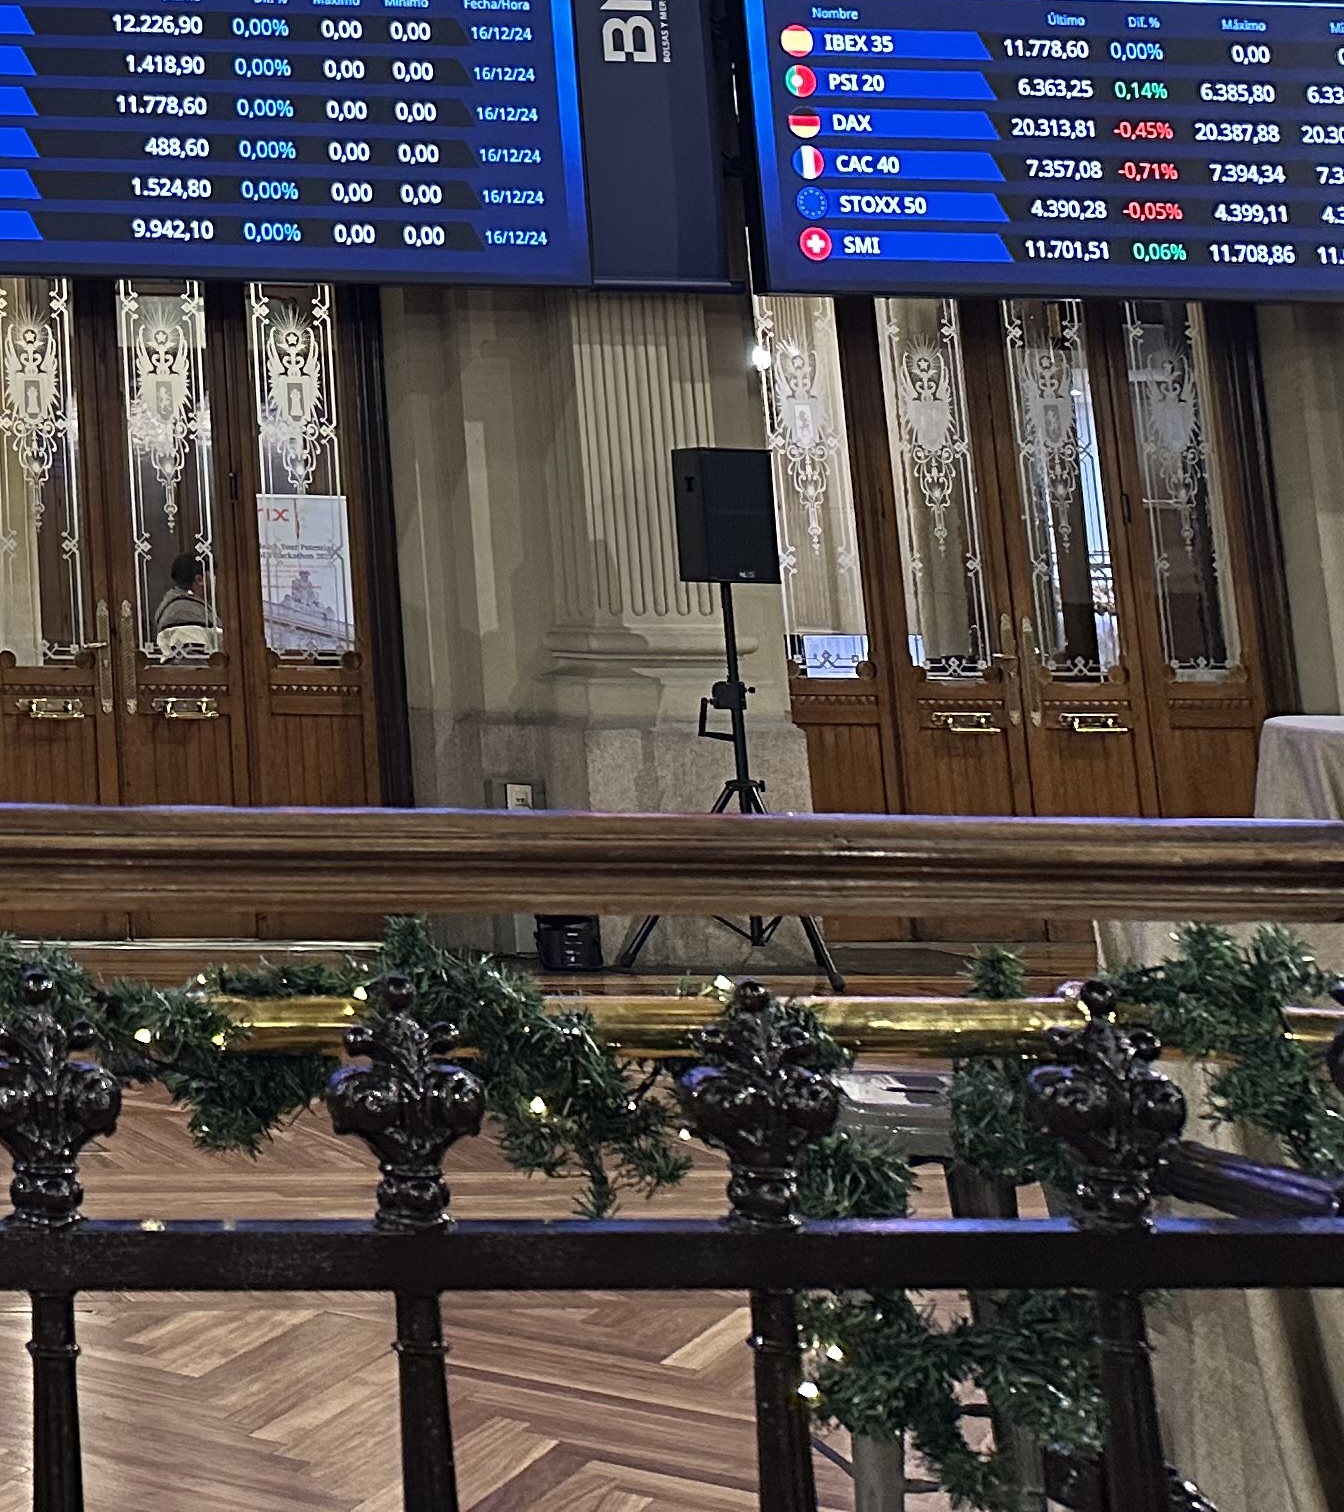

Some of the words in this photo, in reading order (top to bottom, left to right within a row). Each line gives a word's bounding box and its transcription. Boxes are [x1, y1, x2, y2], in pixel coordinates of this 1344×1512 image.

[113, 14, 202, 35] 12.226,90
[233, 18, 289, 37] 0,00%
[321, 20, 362, 40] 0,00
[471, 27, 532, 41] 16/12/24
[833, 114, 872, 131] DAX
[1012, 118, 1095, 139] 20.313,81
[1114, 122, 1173, 140] -0,45%
[1195, 123, 1280, 144] 20.387,88
[839, 196, 903, 214] STOXX
[904, 197, 927, 215] 50
[1031, 200, 1107, 220] 4.390,28
[132, 219, 213, 241] 9.942,10
[844, 236, 880, 254] SMI
[1025, 240, 1109, 261] 11.701,51
[1133, 243, 1186, 262] 0,06%
